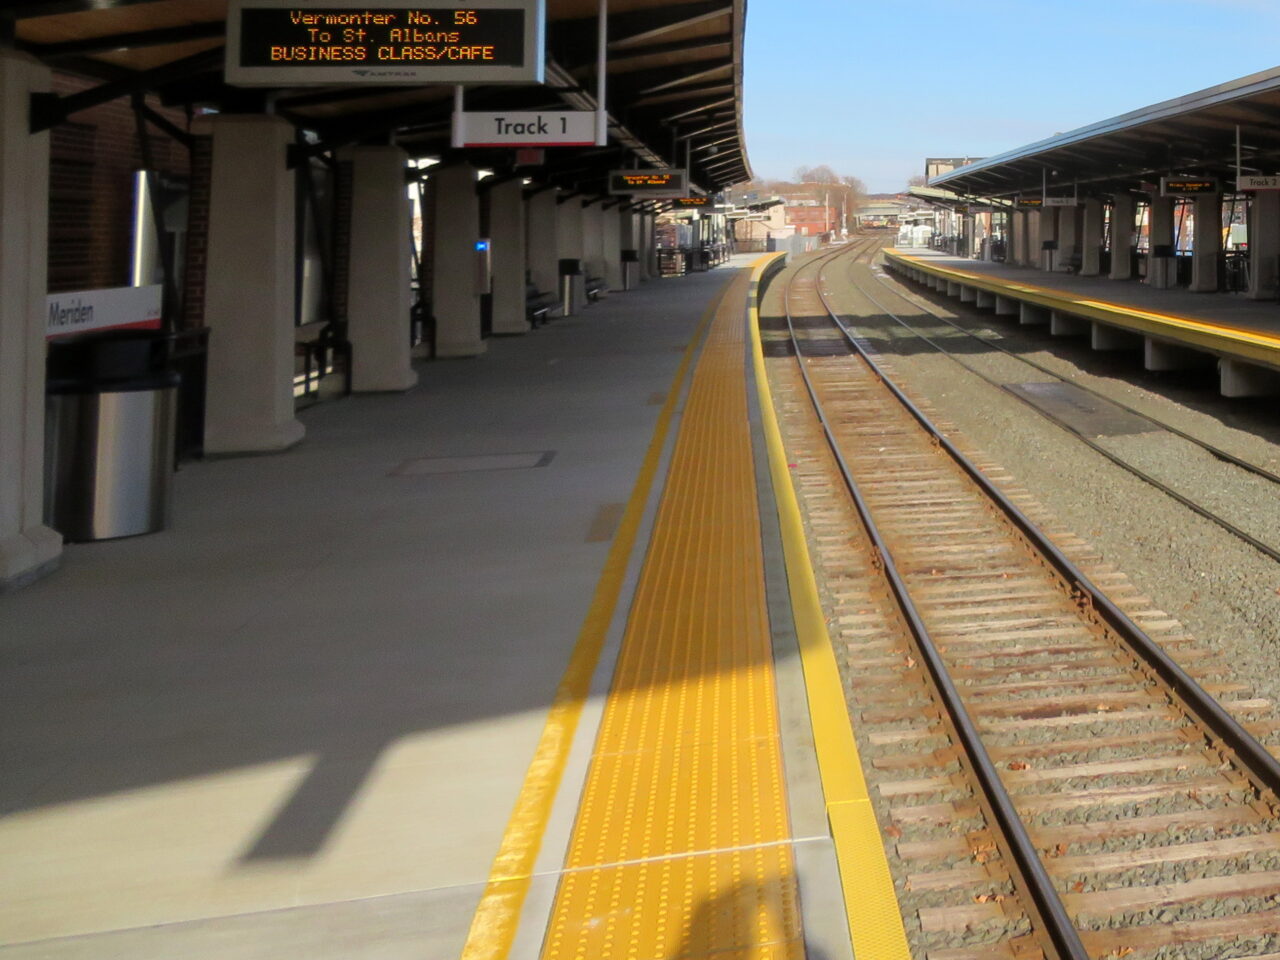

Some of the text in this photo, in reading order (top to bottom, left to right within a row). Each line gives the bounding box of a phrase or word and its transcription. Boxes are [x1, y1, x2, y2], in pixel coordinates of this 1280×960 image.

[290, 10, 478, 25] Vermonter No. 56
[307, 28, 460, 43] To St. Albans
[270, 45, 494, 61] BUSINESS CLASS/CAFE
[494, 115, 567, 135] Track 1
[1249, 178, 1277, 186] Track 2
[48, 298, 94, 328] Meriden
